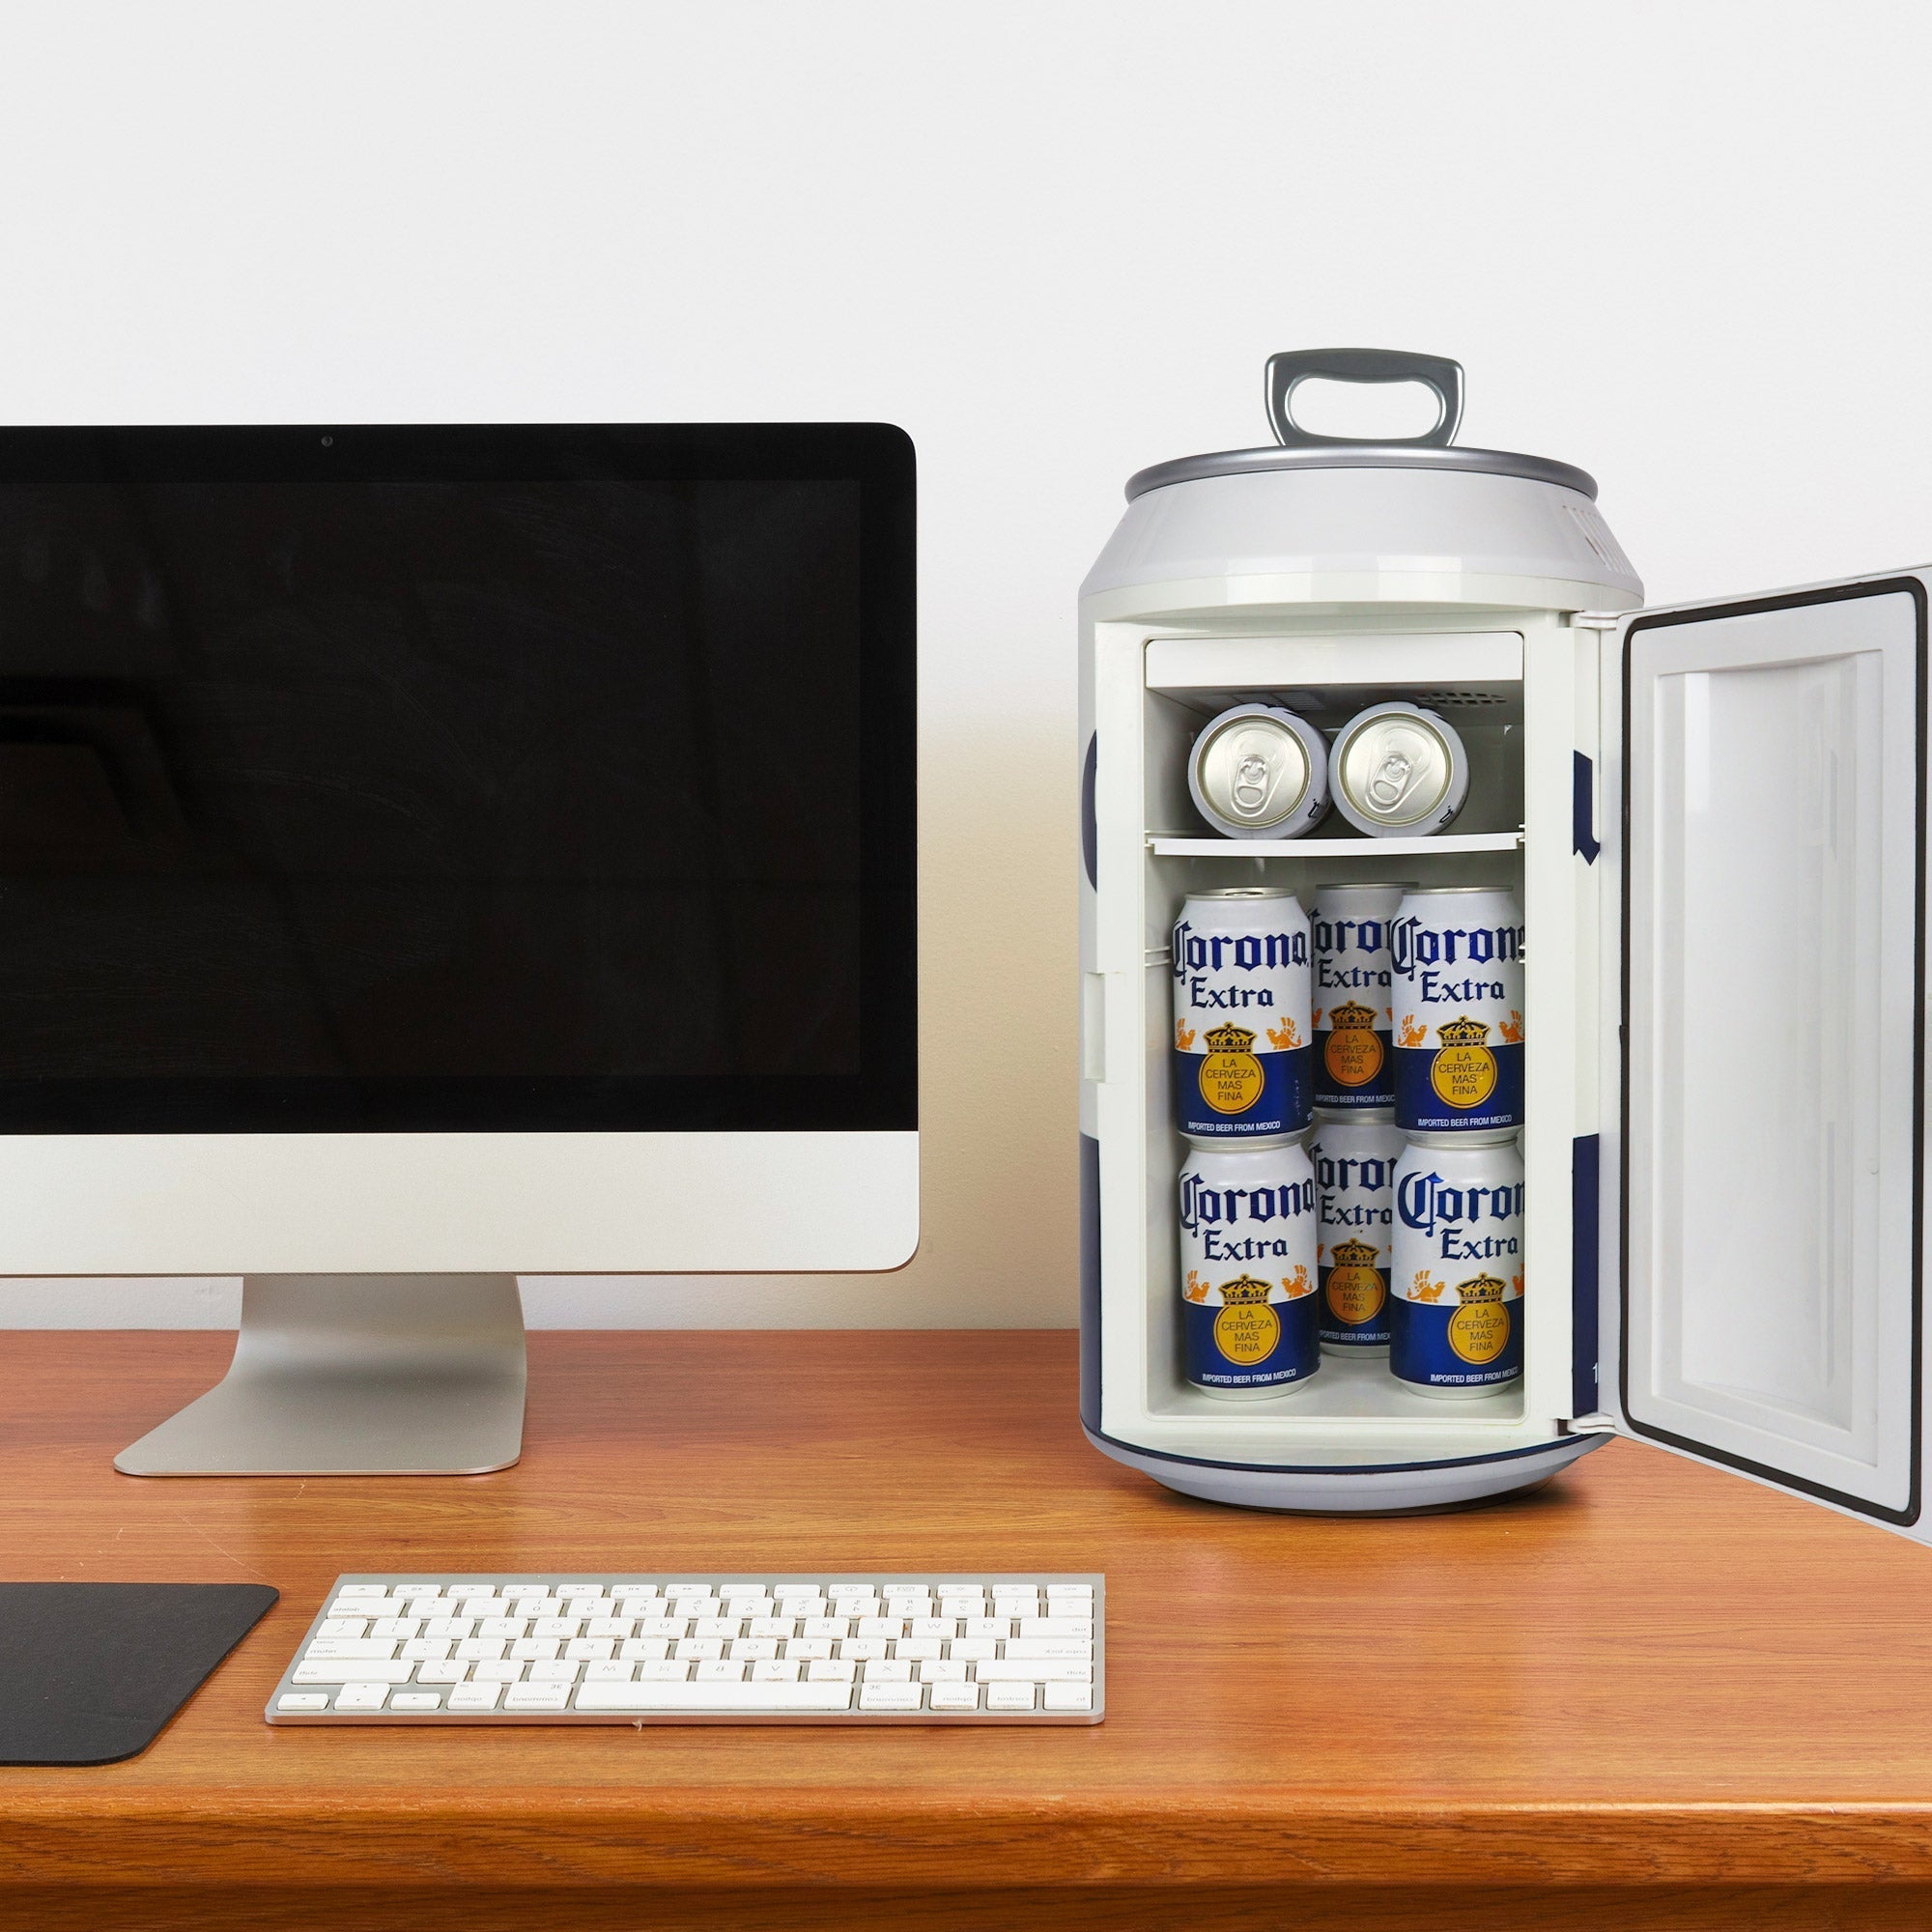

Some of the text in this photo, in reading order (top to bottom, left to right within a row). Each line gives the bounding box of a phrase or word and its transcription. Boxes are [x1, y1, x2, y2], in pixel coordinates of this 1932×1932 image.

[1308, 908, 1392, 969] oro
[1420, 971, 1505, 1002] Extra
[1190, 976, 1274, 1009] Extra
[1346, 1035, 1359, 1043] LA
[1330, 1045, 1376, 1054] CERVEZA
[1457, 1052, 1471, 1062] LA
[1222, 1059, 1237, 1067] LA
[1438, 1063, 1490, 1073] CERVEZA
[1205, 1068, 1256, 1079] CERVEZA
[1341, 1065, 1364, 1074] FINA
[1452, 1074, 1477, 1084] MAS
[1217, 1080, 1243, 1090] MAS
[1452, 1086, 1478, 1094] FINA
[1217, 1092, 1243, 1101] FINA
[1418, 1114, 1512, 1127] IMPORTED BEER FROM MEXICO
[1187, 1121, 1281, 1132] IMPORTED BEER FROM MEXICO
[1179, 1173, 1316, 1237] Corona
[1203, 1229, 1289, 1261] Extra
[1440, 1228, 1519, 1260] Extra
[1238, 1310, 1254, 1320] LA
[1475, 1309, 1490, 1319] LA
[1221, 1320, 1272, 1331] CERVEZA
[1457, 1319, 1504, 1330] CERVEZA
[1235, 1331, 1260, 1342] MAS
[1340, 1332, 1356, 1341] BEER
[1356, 1333, 1376, 1342] FROM
[1469, 1330, 1493, 1341] MAS
[1235, 1343, 1261, 1352] FINA
[1469, 1343, 1493, 1351] FINA
[1202, 1368, 1296, 1383] IMPORTED BEER FROM MEXICO
[1431, 1374, 1464, 1383] IMPORTED
[1465, 1374, 1484, 1382] BEER
[1484, 1371, 1501, 1381] FROM
